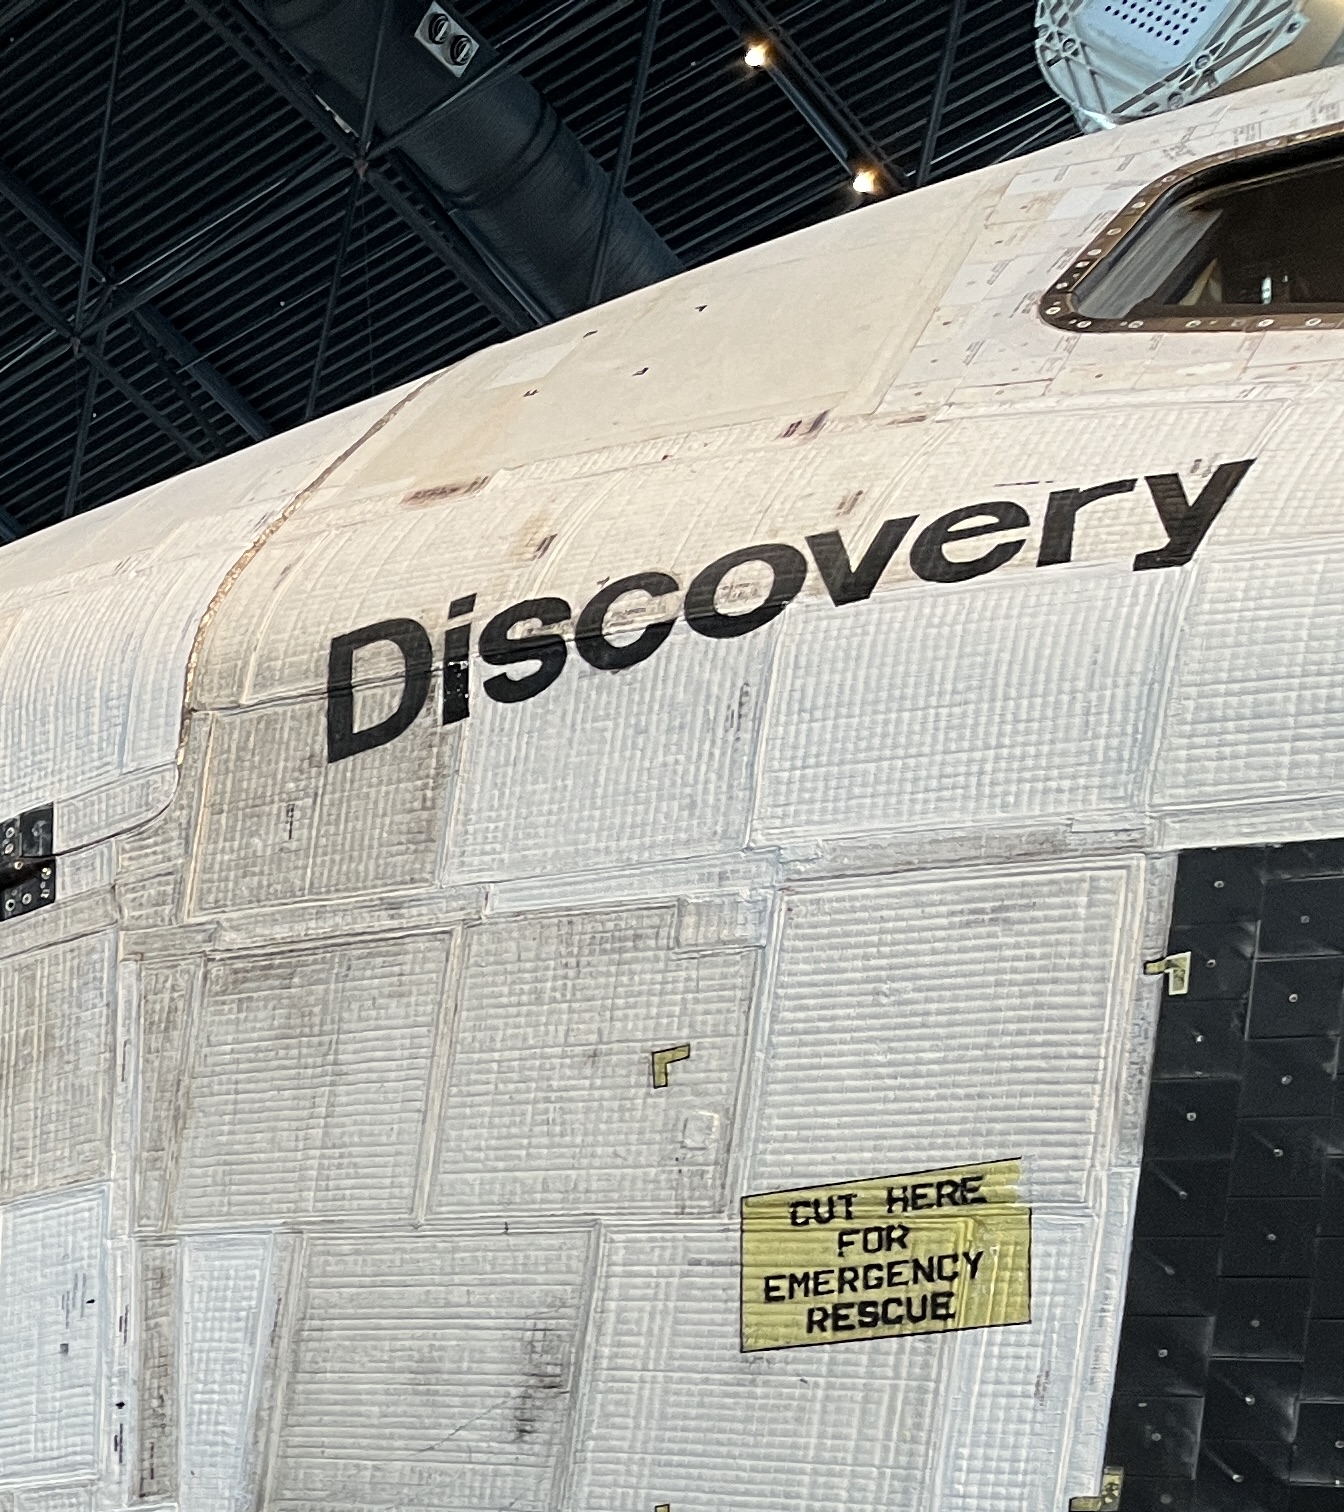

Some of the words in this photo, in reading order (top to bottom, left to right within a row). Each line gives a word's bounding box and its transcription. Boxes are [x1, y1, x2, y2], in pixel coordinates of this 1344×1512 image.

[327, 456, 1256, 763] Discovery
[790, 1194, 857, 1226] CUT
[887, 1175, 987, 1214] HERE
[838, 1224, 910, 1257] FOR
[764, 1251, 984, 1304] EMERGENCY
[806, 1291, 956, 1333] RESCUE
